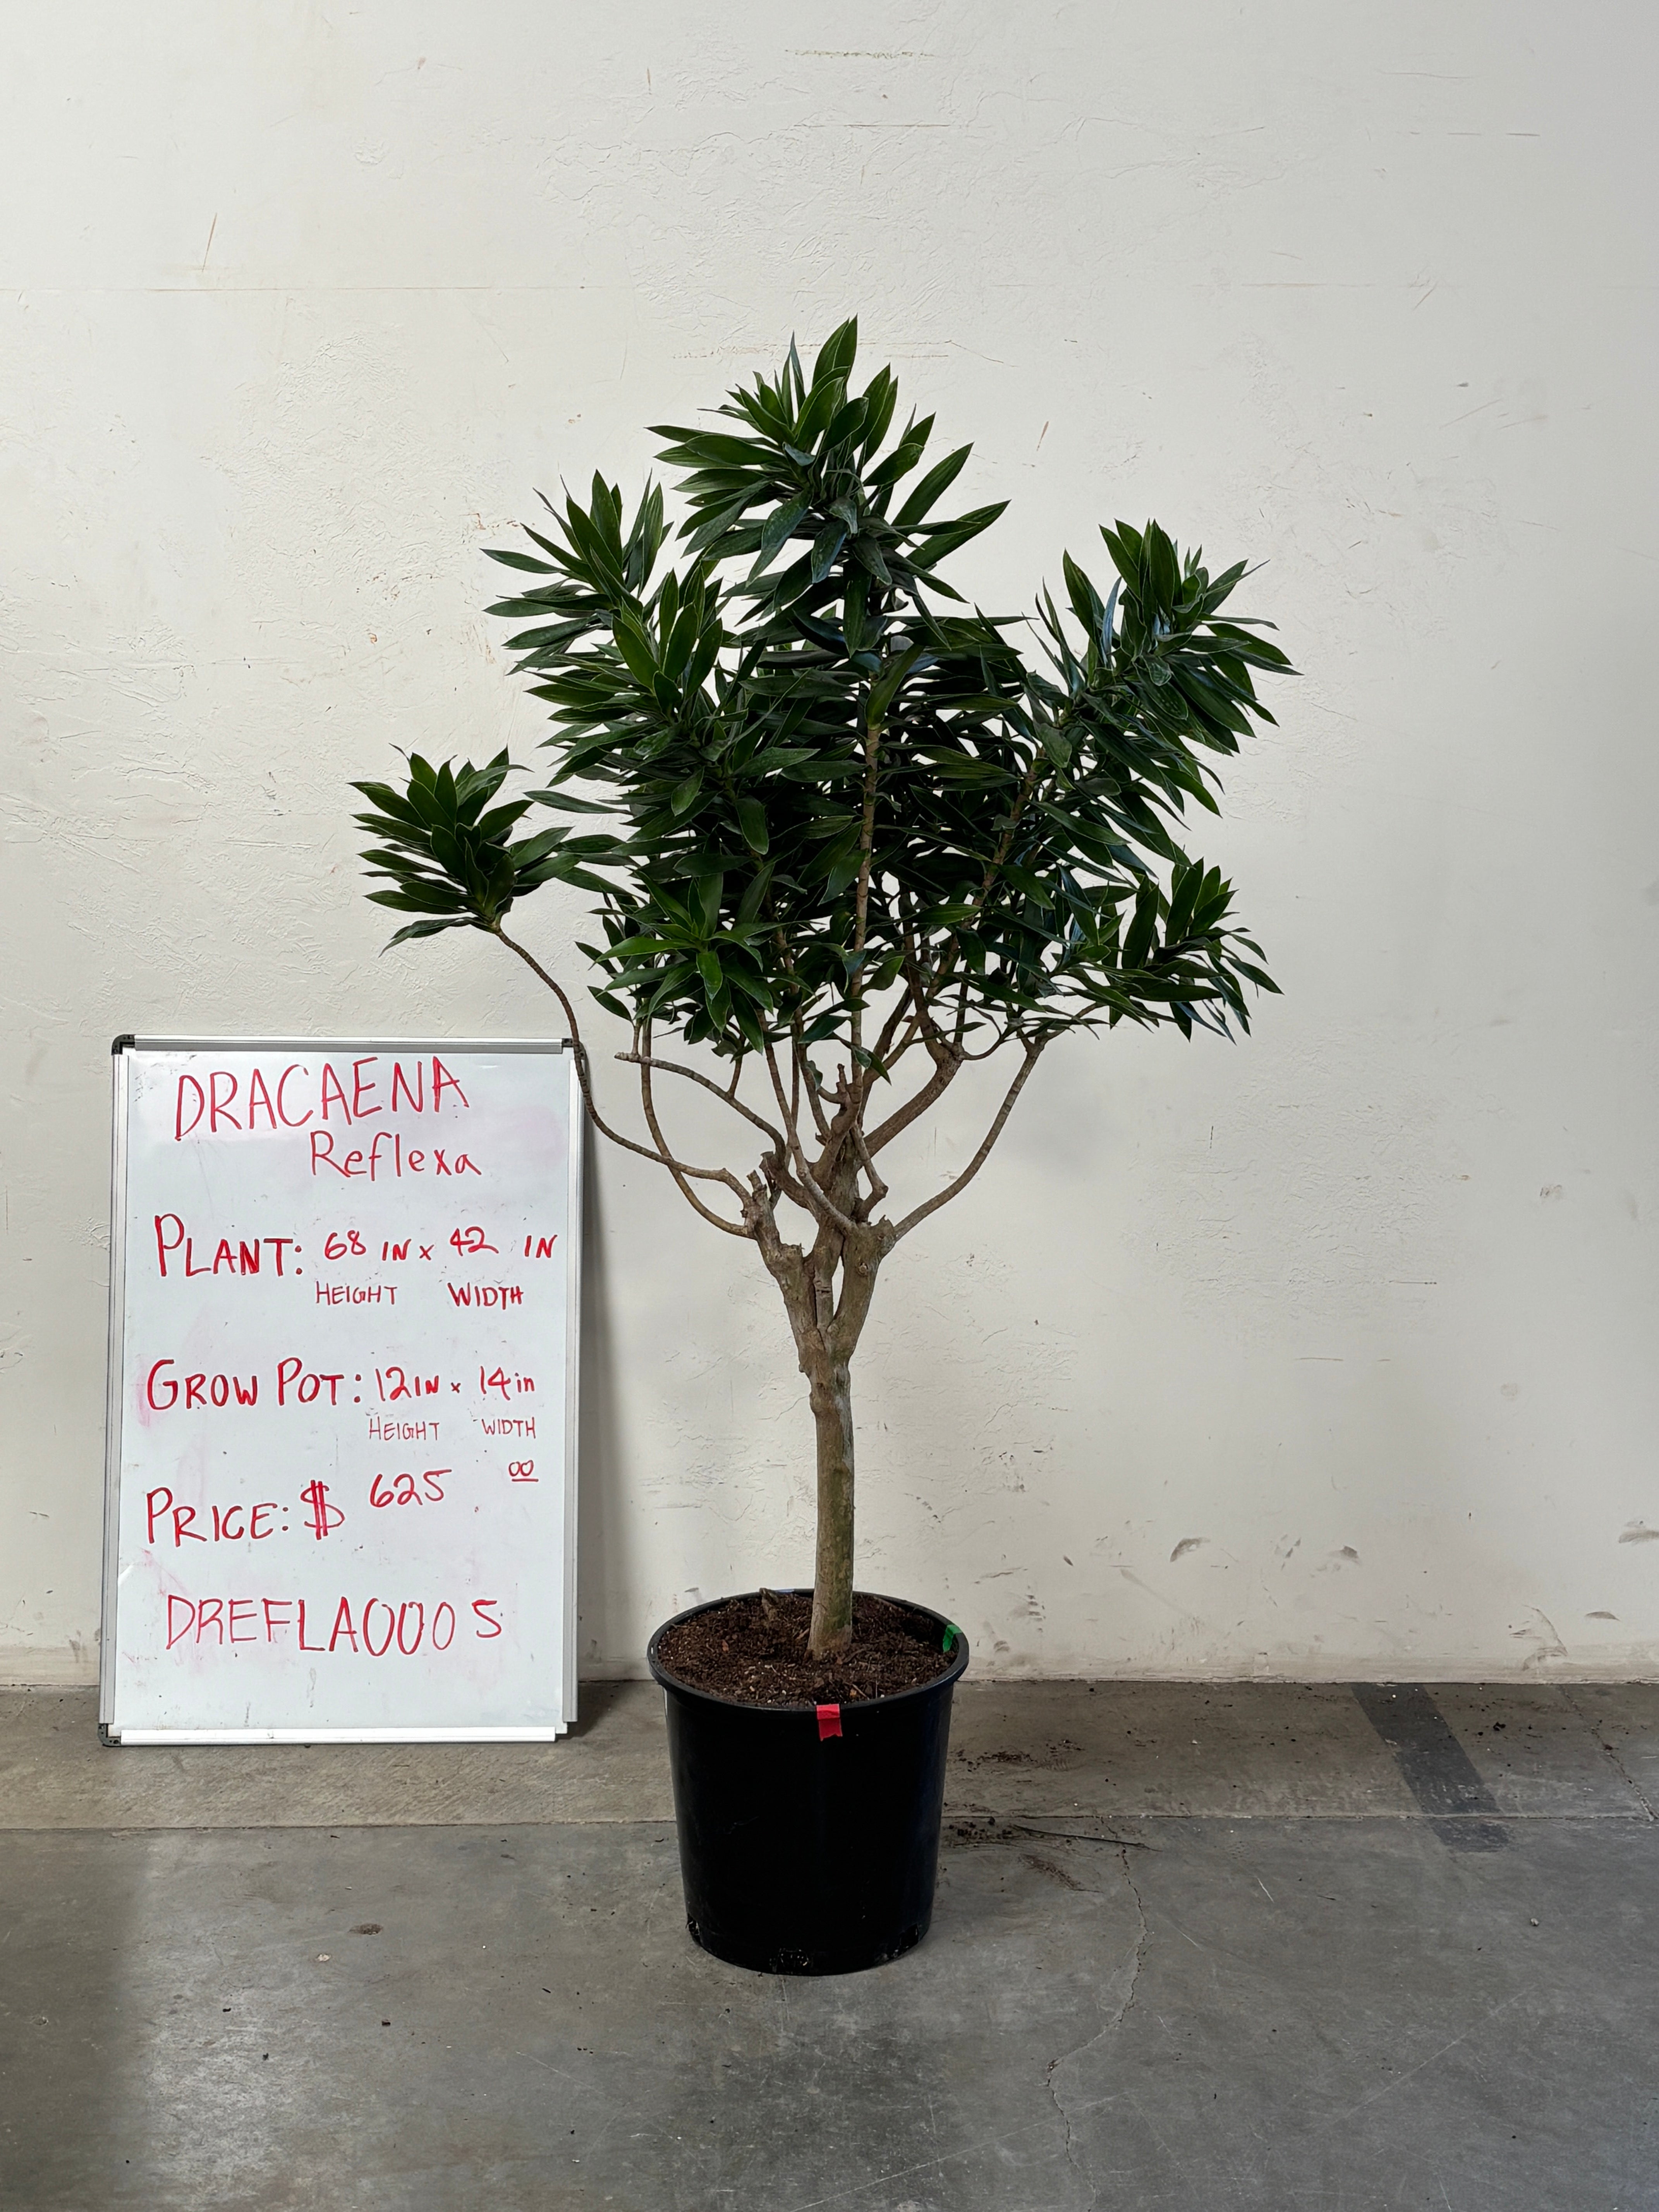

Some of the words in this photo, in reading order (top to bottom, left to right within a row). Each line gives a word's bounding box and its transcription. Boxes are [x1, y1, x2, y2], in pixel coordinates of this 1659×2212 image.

[175, 1056, 469, 1141] DRACAENA
[310, 1130, 481, 1182] Reflexa
[154, 1213, 302, 1278] PLANT:
[324, 1230, 367, 1261] 68
[381, 1238, 411, 1261] IN
[449, 1226, 499, 1256] 42
[524, 1235, 557, 1259] IN
[316, 1282, 398, 1305] HEIGHT
[447, 1283, 524, 1310] WIDTH
[147, 1358, 258, 1411] GROW
[276, 1357, 362, 1406] POT:
[369, 1416, 440, 1441] HEIGHT
[481, 1417, 536, 1439] WIDTH
[146, 1487, 290, 1547] PRICE:
[369, 1469, 452, 1508] 625
